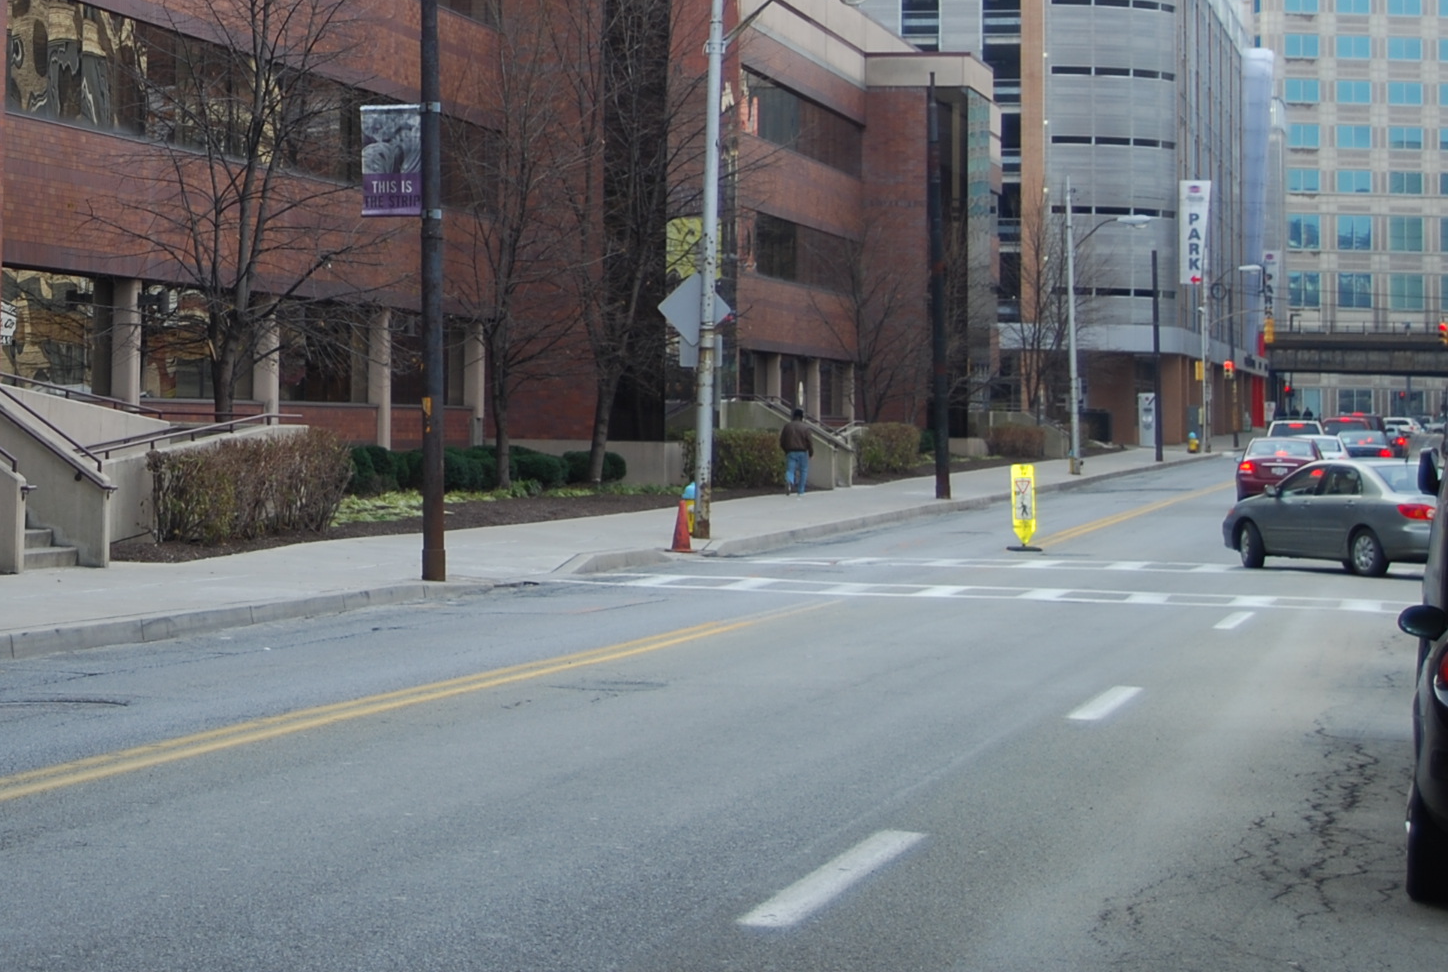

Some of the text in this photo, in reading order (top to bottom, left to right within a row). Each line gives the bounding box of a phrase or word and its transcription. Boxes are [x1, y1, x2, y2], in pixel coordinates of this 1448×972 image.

[372, 181, 413, 194] THIS IS
[364, 195, 421, 208] THE STRIP
[1188, 213, 1201, 270] PARK
